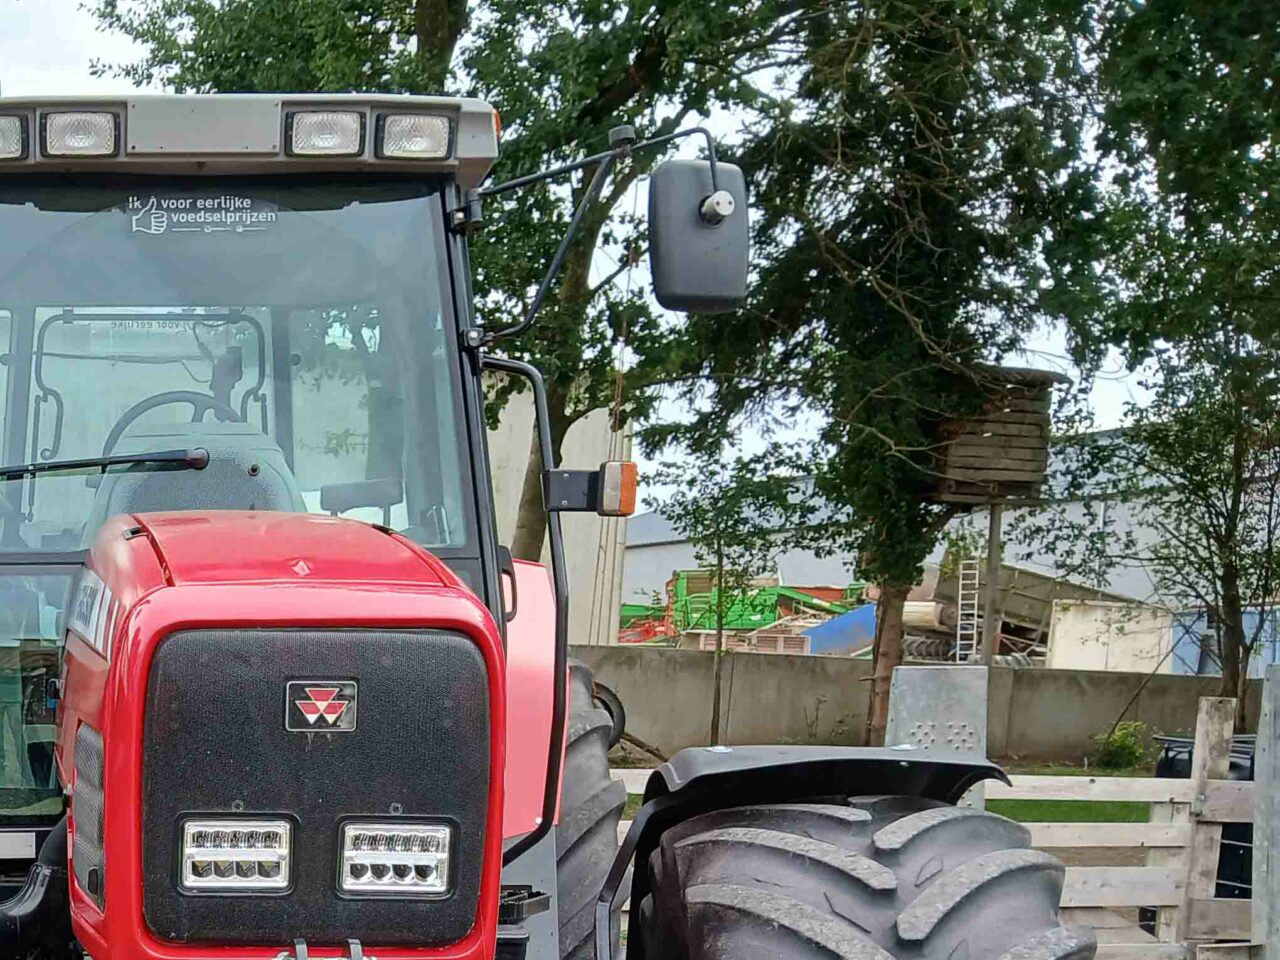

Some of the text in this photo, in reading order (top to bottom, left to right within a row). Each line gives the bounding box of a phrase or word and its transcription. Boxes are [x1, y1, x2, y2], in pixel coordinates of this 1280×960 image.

[128, 196, 252, 211] Ik voor eerlijke
[171, 210, 276, 224] voedselprijzen
